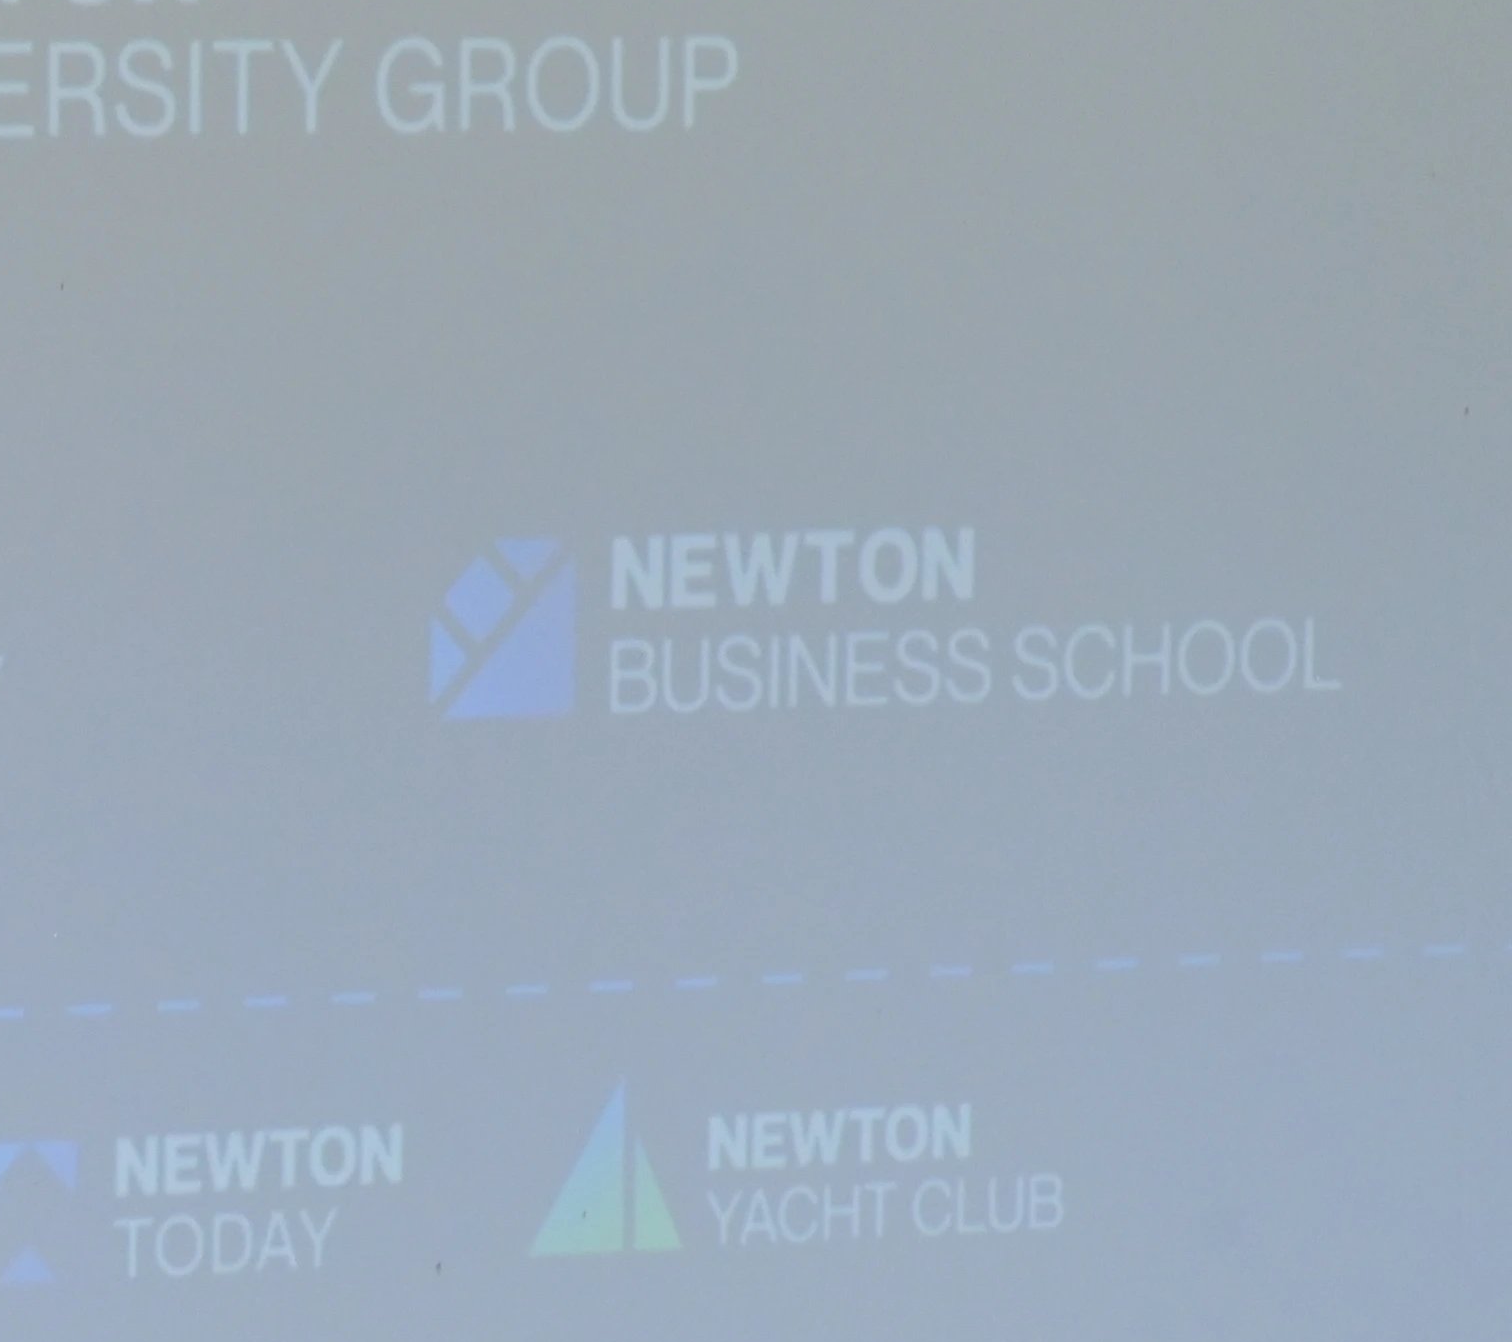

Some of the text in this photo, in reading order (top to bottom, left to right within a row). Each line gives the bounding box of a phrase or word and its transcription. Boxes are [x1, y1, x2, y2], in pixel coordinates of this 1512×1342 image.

[375, 35, 740, 133] GROUP
[610, 526, 976, 609] NEWTON
[608, 617, 1344, 715] BUSINESS SCHOOL
[115, 1124, 403, 1197] NEWTON
[707, 1102, 973, 1169] NEWTON
[114, 1208, 340, 1278] TODAY
[707, 1174, 1065, 1245] YACHT CLUB
